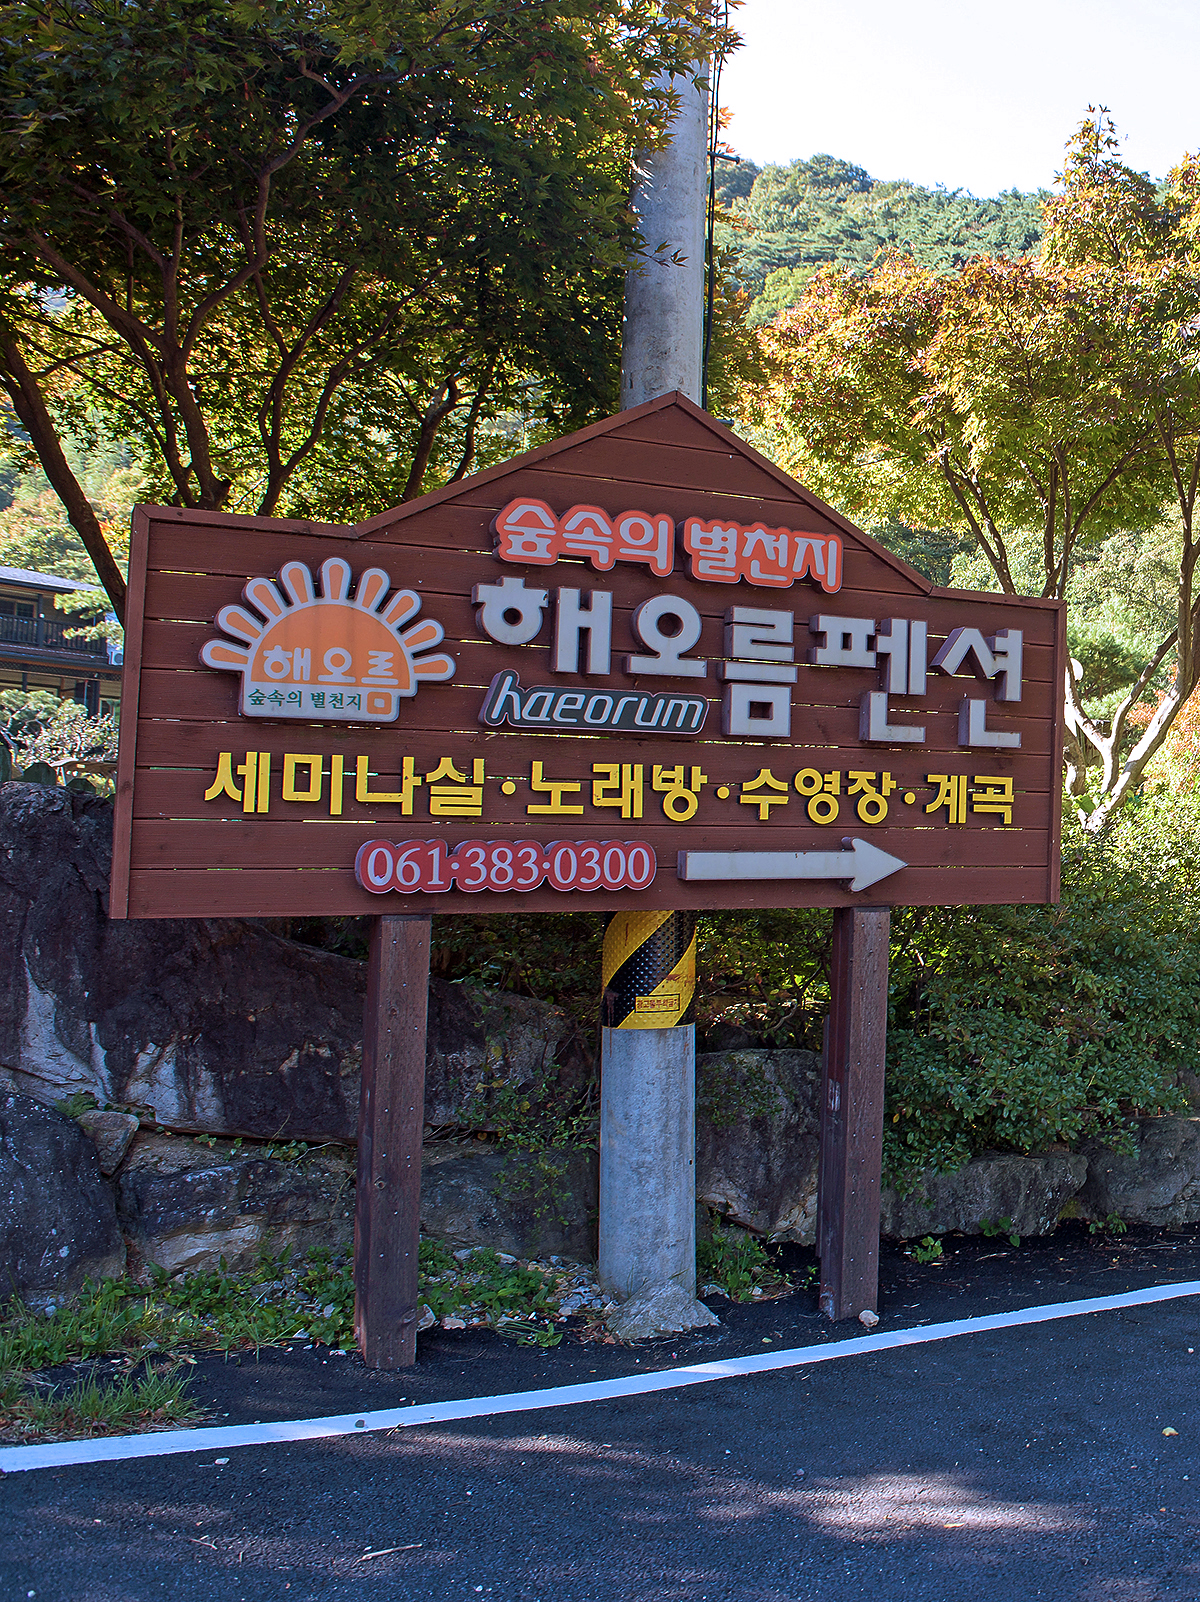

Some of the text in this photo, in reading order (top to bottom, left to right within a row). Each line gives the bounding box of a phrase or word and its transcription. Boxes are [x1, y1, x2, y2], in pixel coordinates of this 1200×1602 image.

[503, 504, 838, 587] 숲속의 별천지
[247, 688, 362, 711] 숲속의 별천지
[262, 644, 399, 715] 해오름
[490, 675, 704, 728] haeorum
